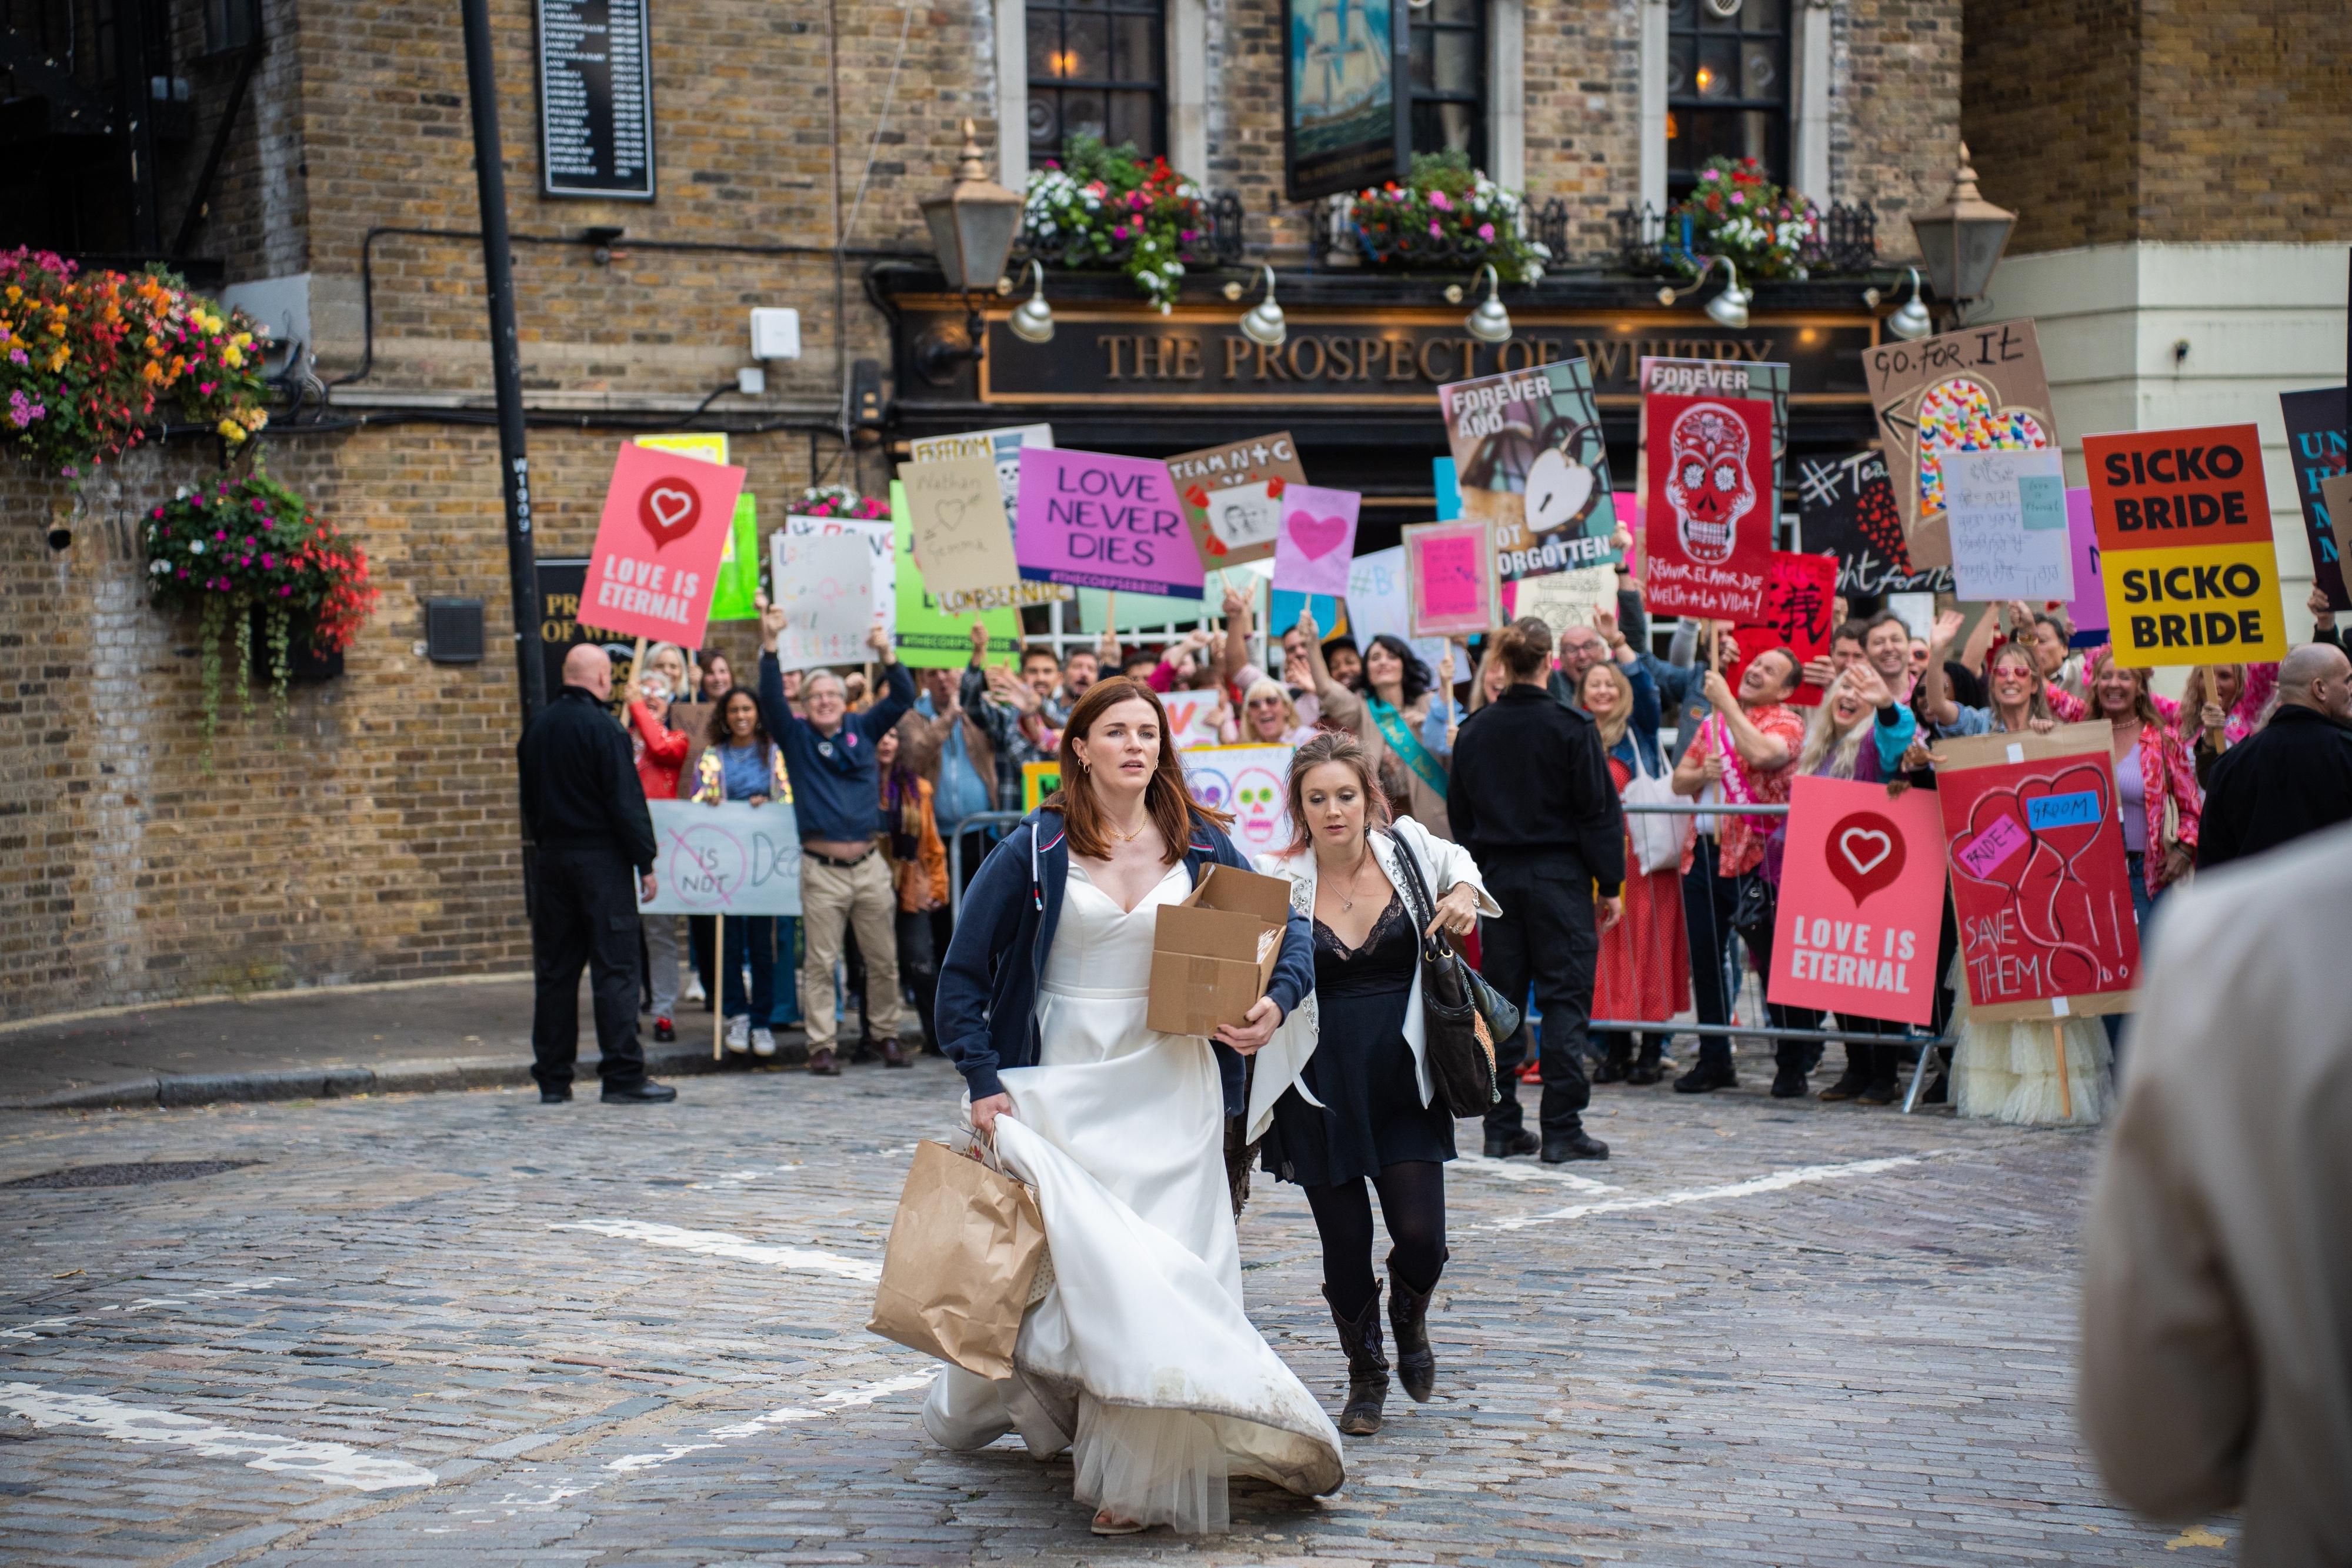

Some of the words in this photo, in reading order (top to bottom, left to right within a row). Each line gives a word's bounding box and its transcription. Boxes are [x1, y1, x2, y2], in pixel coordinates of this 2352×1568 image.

[1097, 335, 1204, 379] THE
[1223, 335, 1484, 382] PROSPECT
[1497, 337, 1562, 373] OF
[1651, 366, 1749, 391] FOREVER
[1452, 375, 1552, 414] FOREVER
[1457, 412, 1504, 439] AND
[1058, 467, 1159, 502] LOVE
[1169, 452, 1227, 481] TEAM
[1799, 449, 1889, 507] #Tea
[2106, 445, 2244, 486] SICKO
[1047, 498, 1180, 538] NEVER
[2114, 491, 2248, 532] BRIDE
[1067, 532, 1155, 566] DIES
[1497, 524, 1522, 548] OT
[1499, 534, 1611, 575] ORGOTTEN
[604, 555, 666, 589] LOVE
[672, 570, 699, 598] IS
[1741, 573, 1764, 590] DE
[2123, 563, 2261, 603] SICKO
[598, 582, 689, 625] ETERNAL
[541, 620, 576, 643] OF
[2131, 609, 2264, 649] BRIDE
[2033, 797, 2087, 823] GROOM
[682, 873, 729, 894] NOT
[1794, 915, 1871, 954] LOVE
[1884, 929, 1916, 960] IS
[1966, 909, 2017, 952] SAVE
[1791, 949, 1910, 994] ETERNAL
[1969, 954, 2041, 1003] THEM
